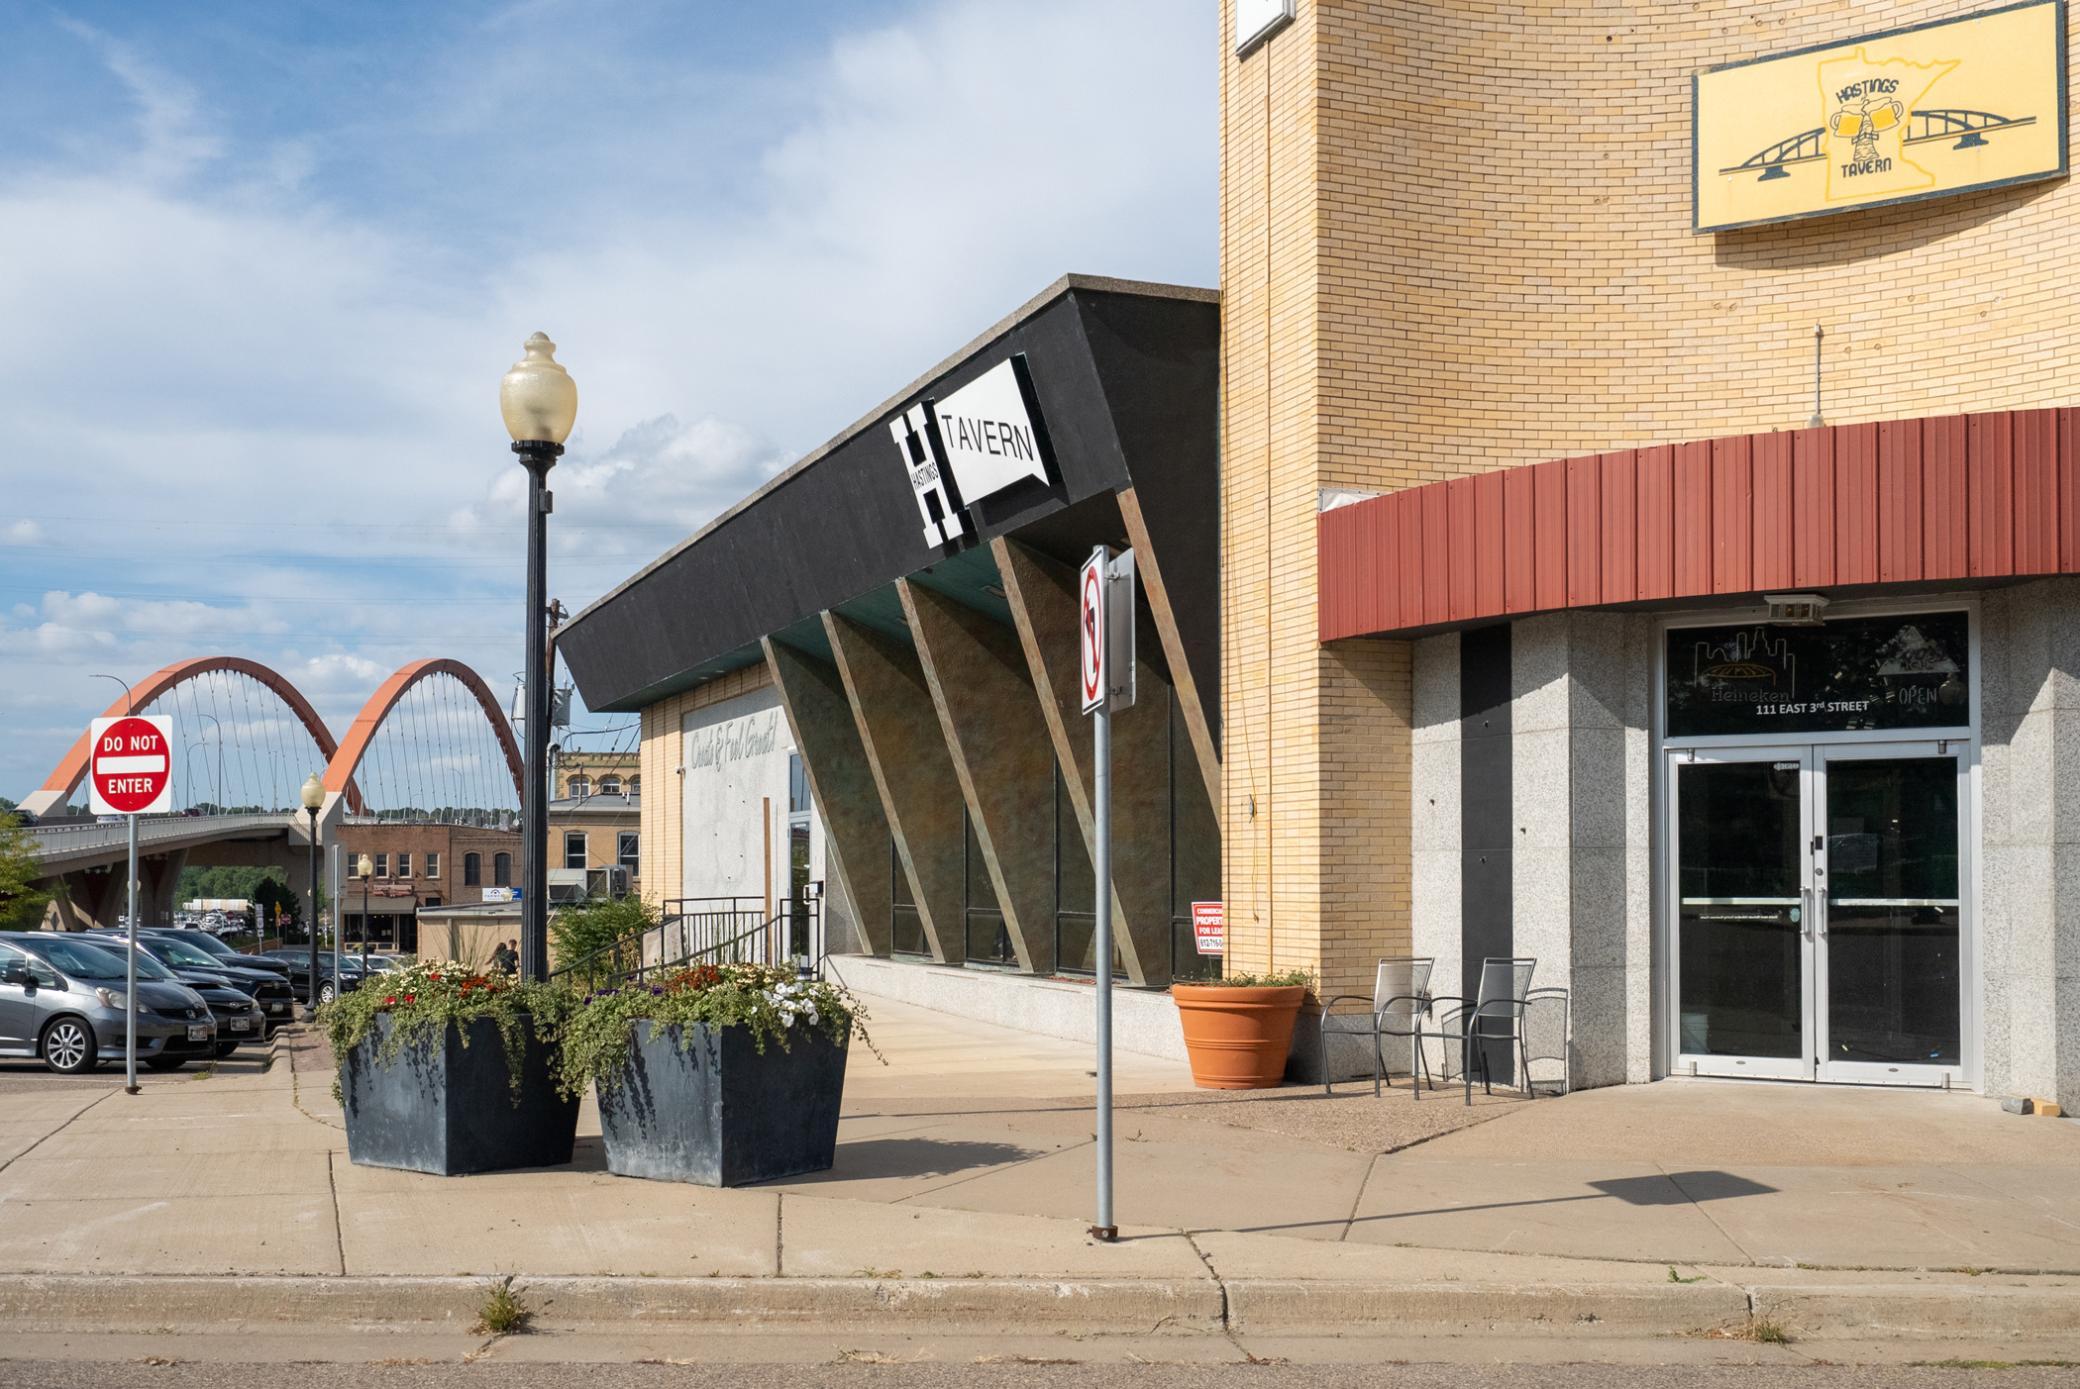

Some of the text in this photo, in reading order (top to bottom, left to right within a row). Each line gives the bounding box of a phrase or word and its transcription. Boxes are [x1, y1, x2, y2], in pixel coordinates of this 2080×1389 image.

[1835, 78, 1900, 105] HASTINGS
[1841, 157, 1892, 179] TAVERN
[941, 414, 1034, 462] TAVERN
[911, 461, 939, 490] HASTINGS
[1711, 687, 1790, 703] Heineken
[1898, 686, 1938, 705] OPEN
[1756, 700, 1870, 716] 111 EAST 3rd STREET
[104, 735, 158, 752] DO NOT
[107, 777, 153, 795] ENTER
